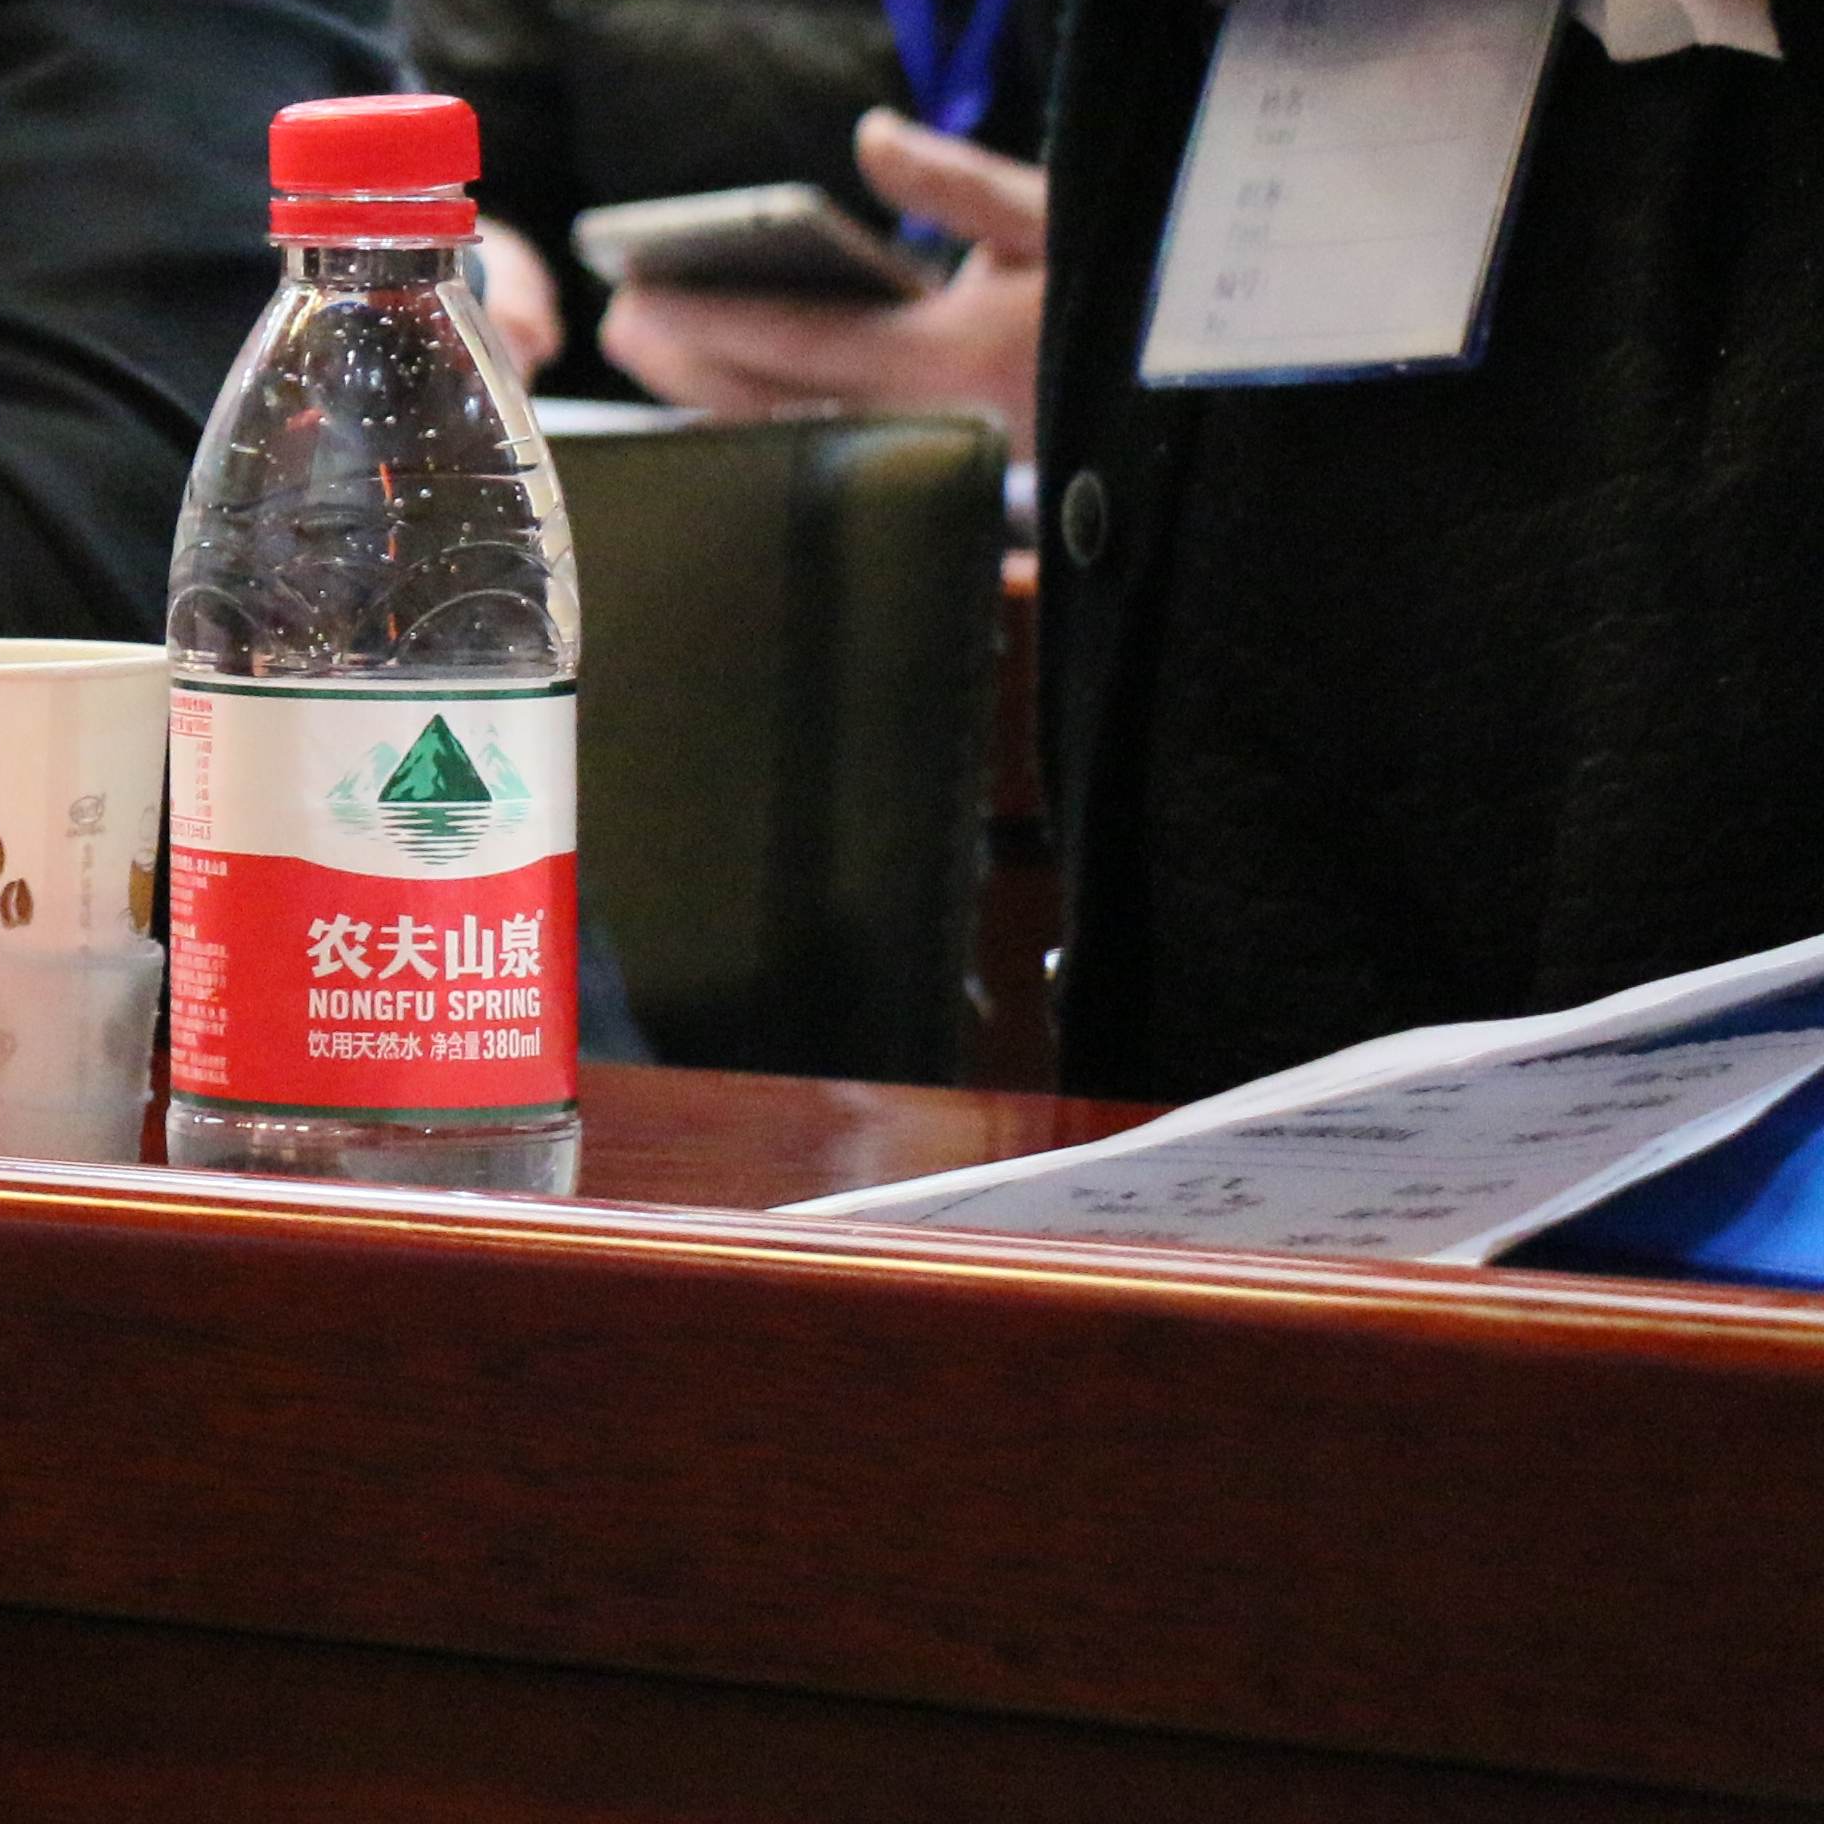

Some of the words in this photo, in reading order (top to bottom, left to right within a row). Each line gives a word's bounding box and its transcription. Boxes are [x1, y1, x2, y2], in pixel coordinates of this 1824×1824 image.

[306, 912, 543, 981] 农夫山泉
[308, 988, 435, 1022] NONGFU
[448, 987, 541, 1021] SPRING
[308, 1030, 423, 1060] 饮用天然水
